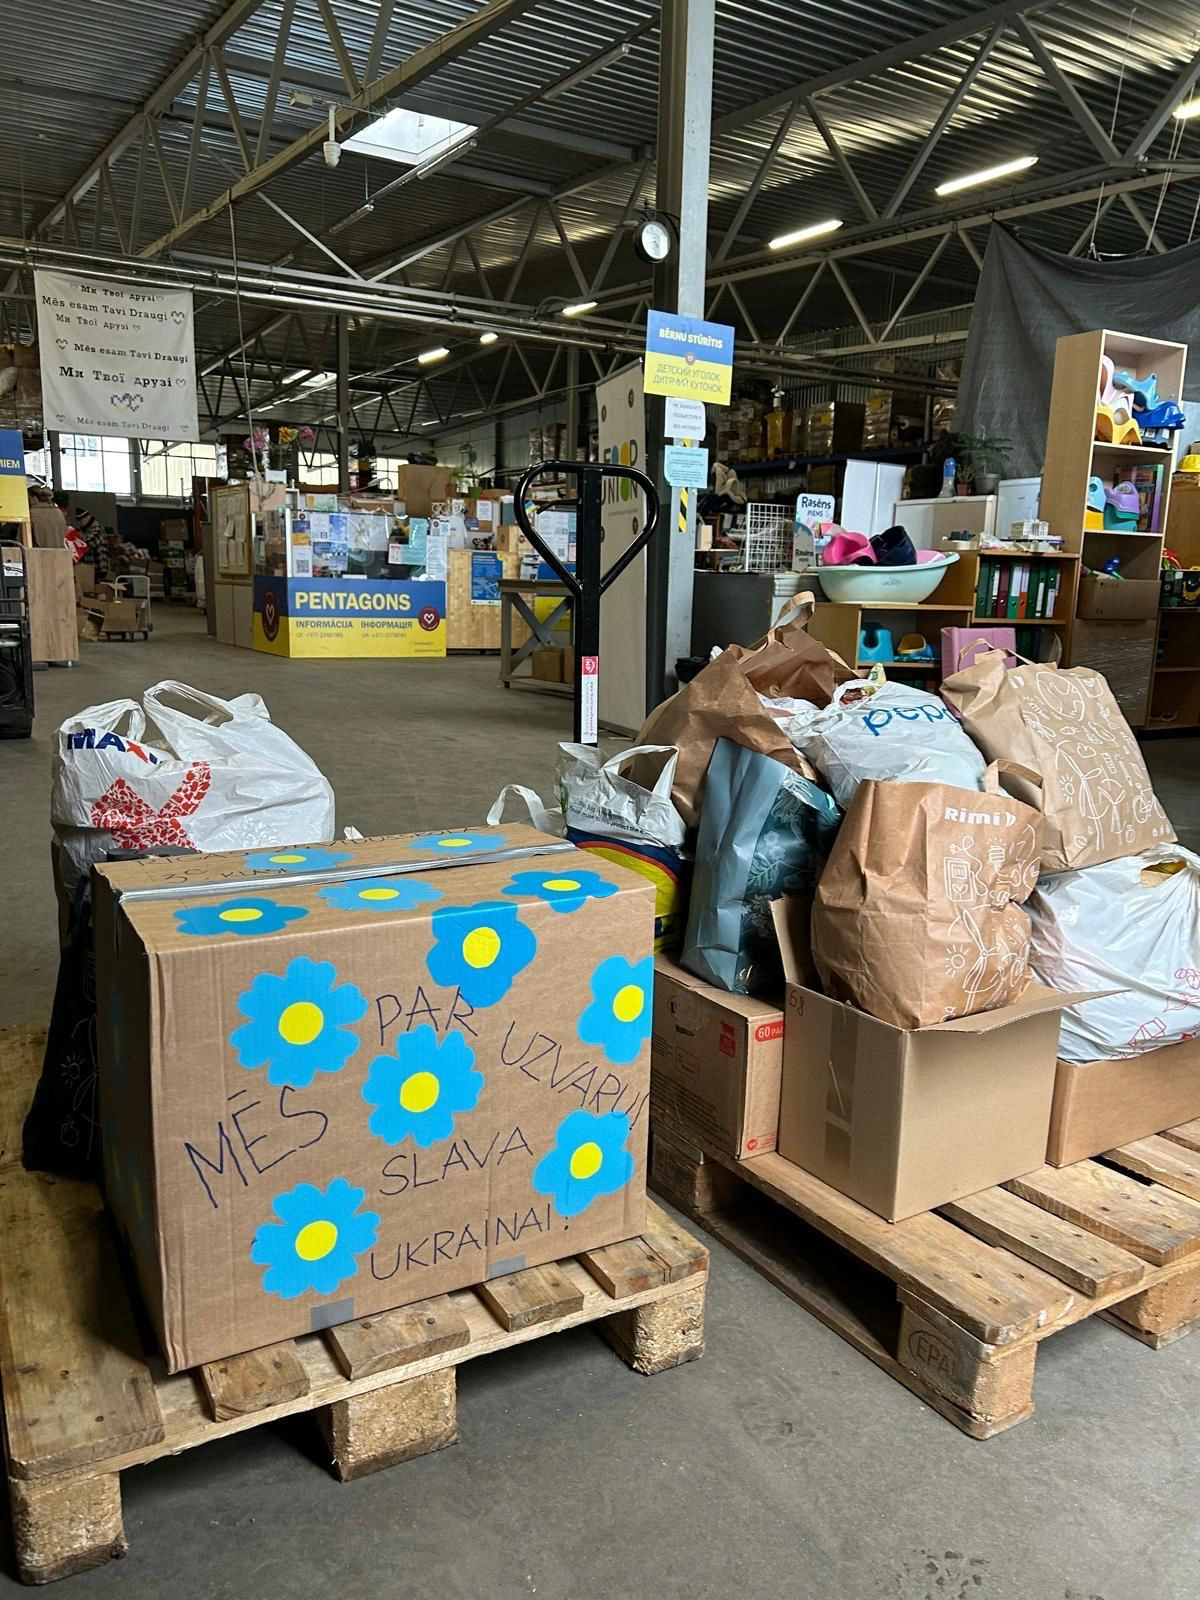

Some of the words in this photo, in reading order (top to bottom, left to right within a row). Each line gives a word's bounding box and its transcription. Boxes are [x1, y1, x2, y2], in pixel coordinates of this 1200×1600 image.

[42, 295, 65, 307] Mēs
[70, 300, 98, 312] esam
[102, 305, 126, 316] Tavi
[130, 309, 168, 323] Draugi
[154, 352, 189, 364] Draugi
[59, 366, 84, 378] Ми
[93, 370, 125, 383] Твої
[134, 376, 172, 388] друзі
[295, 591, 411, 611] PENTAGONS
[944, 807, 1000, 826] Rimi
[376, 985, 478, 1047] PAR
[758, 1025, 771, 1039] 60
[184, 1085, 329, 1209] MĒS
[379, 1126, 533, 1196] SLAVA
